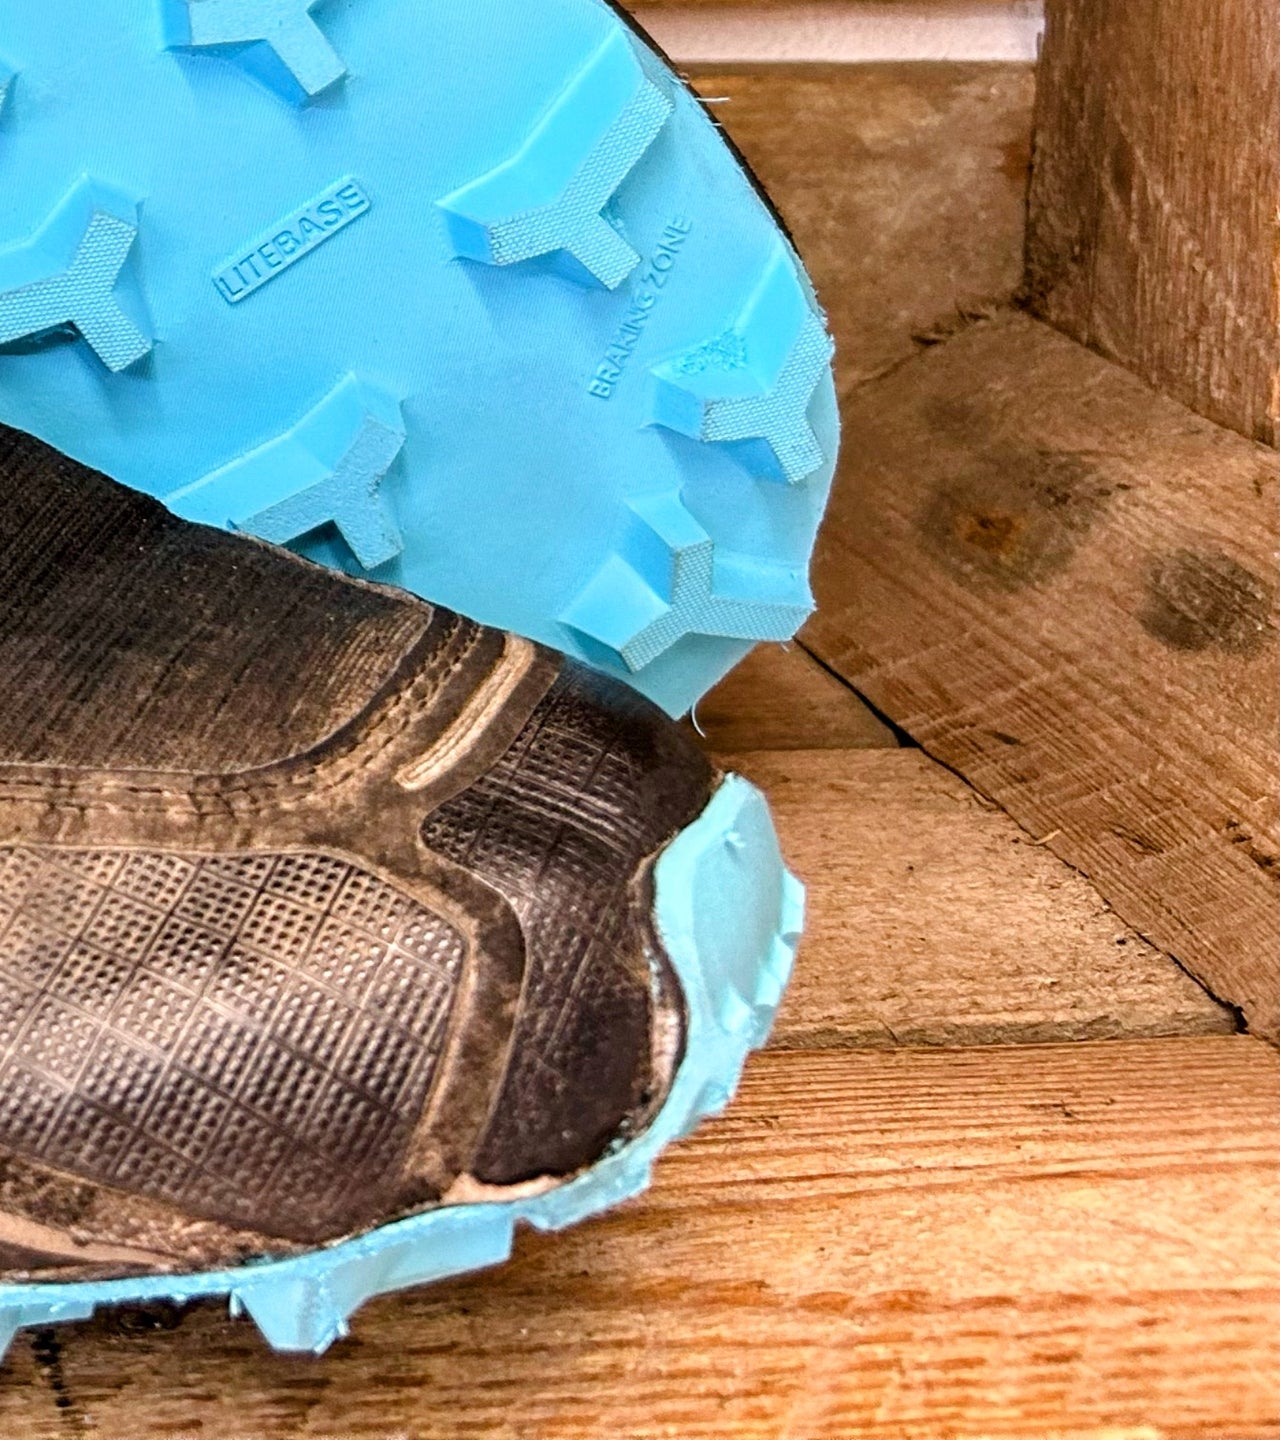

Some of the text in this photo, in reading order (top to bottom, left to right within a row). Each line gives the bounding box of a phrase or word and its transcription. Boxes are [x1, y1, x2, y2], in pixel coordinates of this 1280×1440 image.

[219, 182, 367, 297] LITEBASE
[587, 215, 693, 400] BRAKING ZONE
